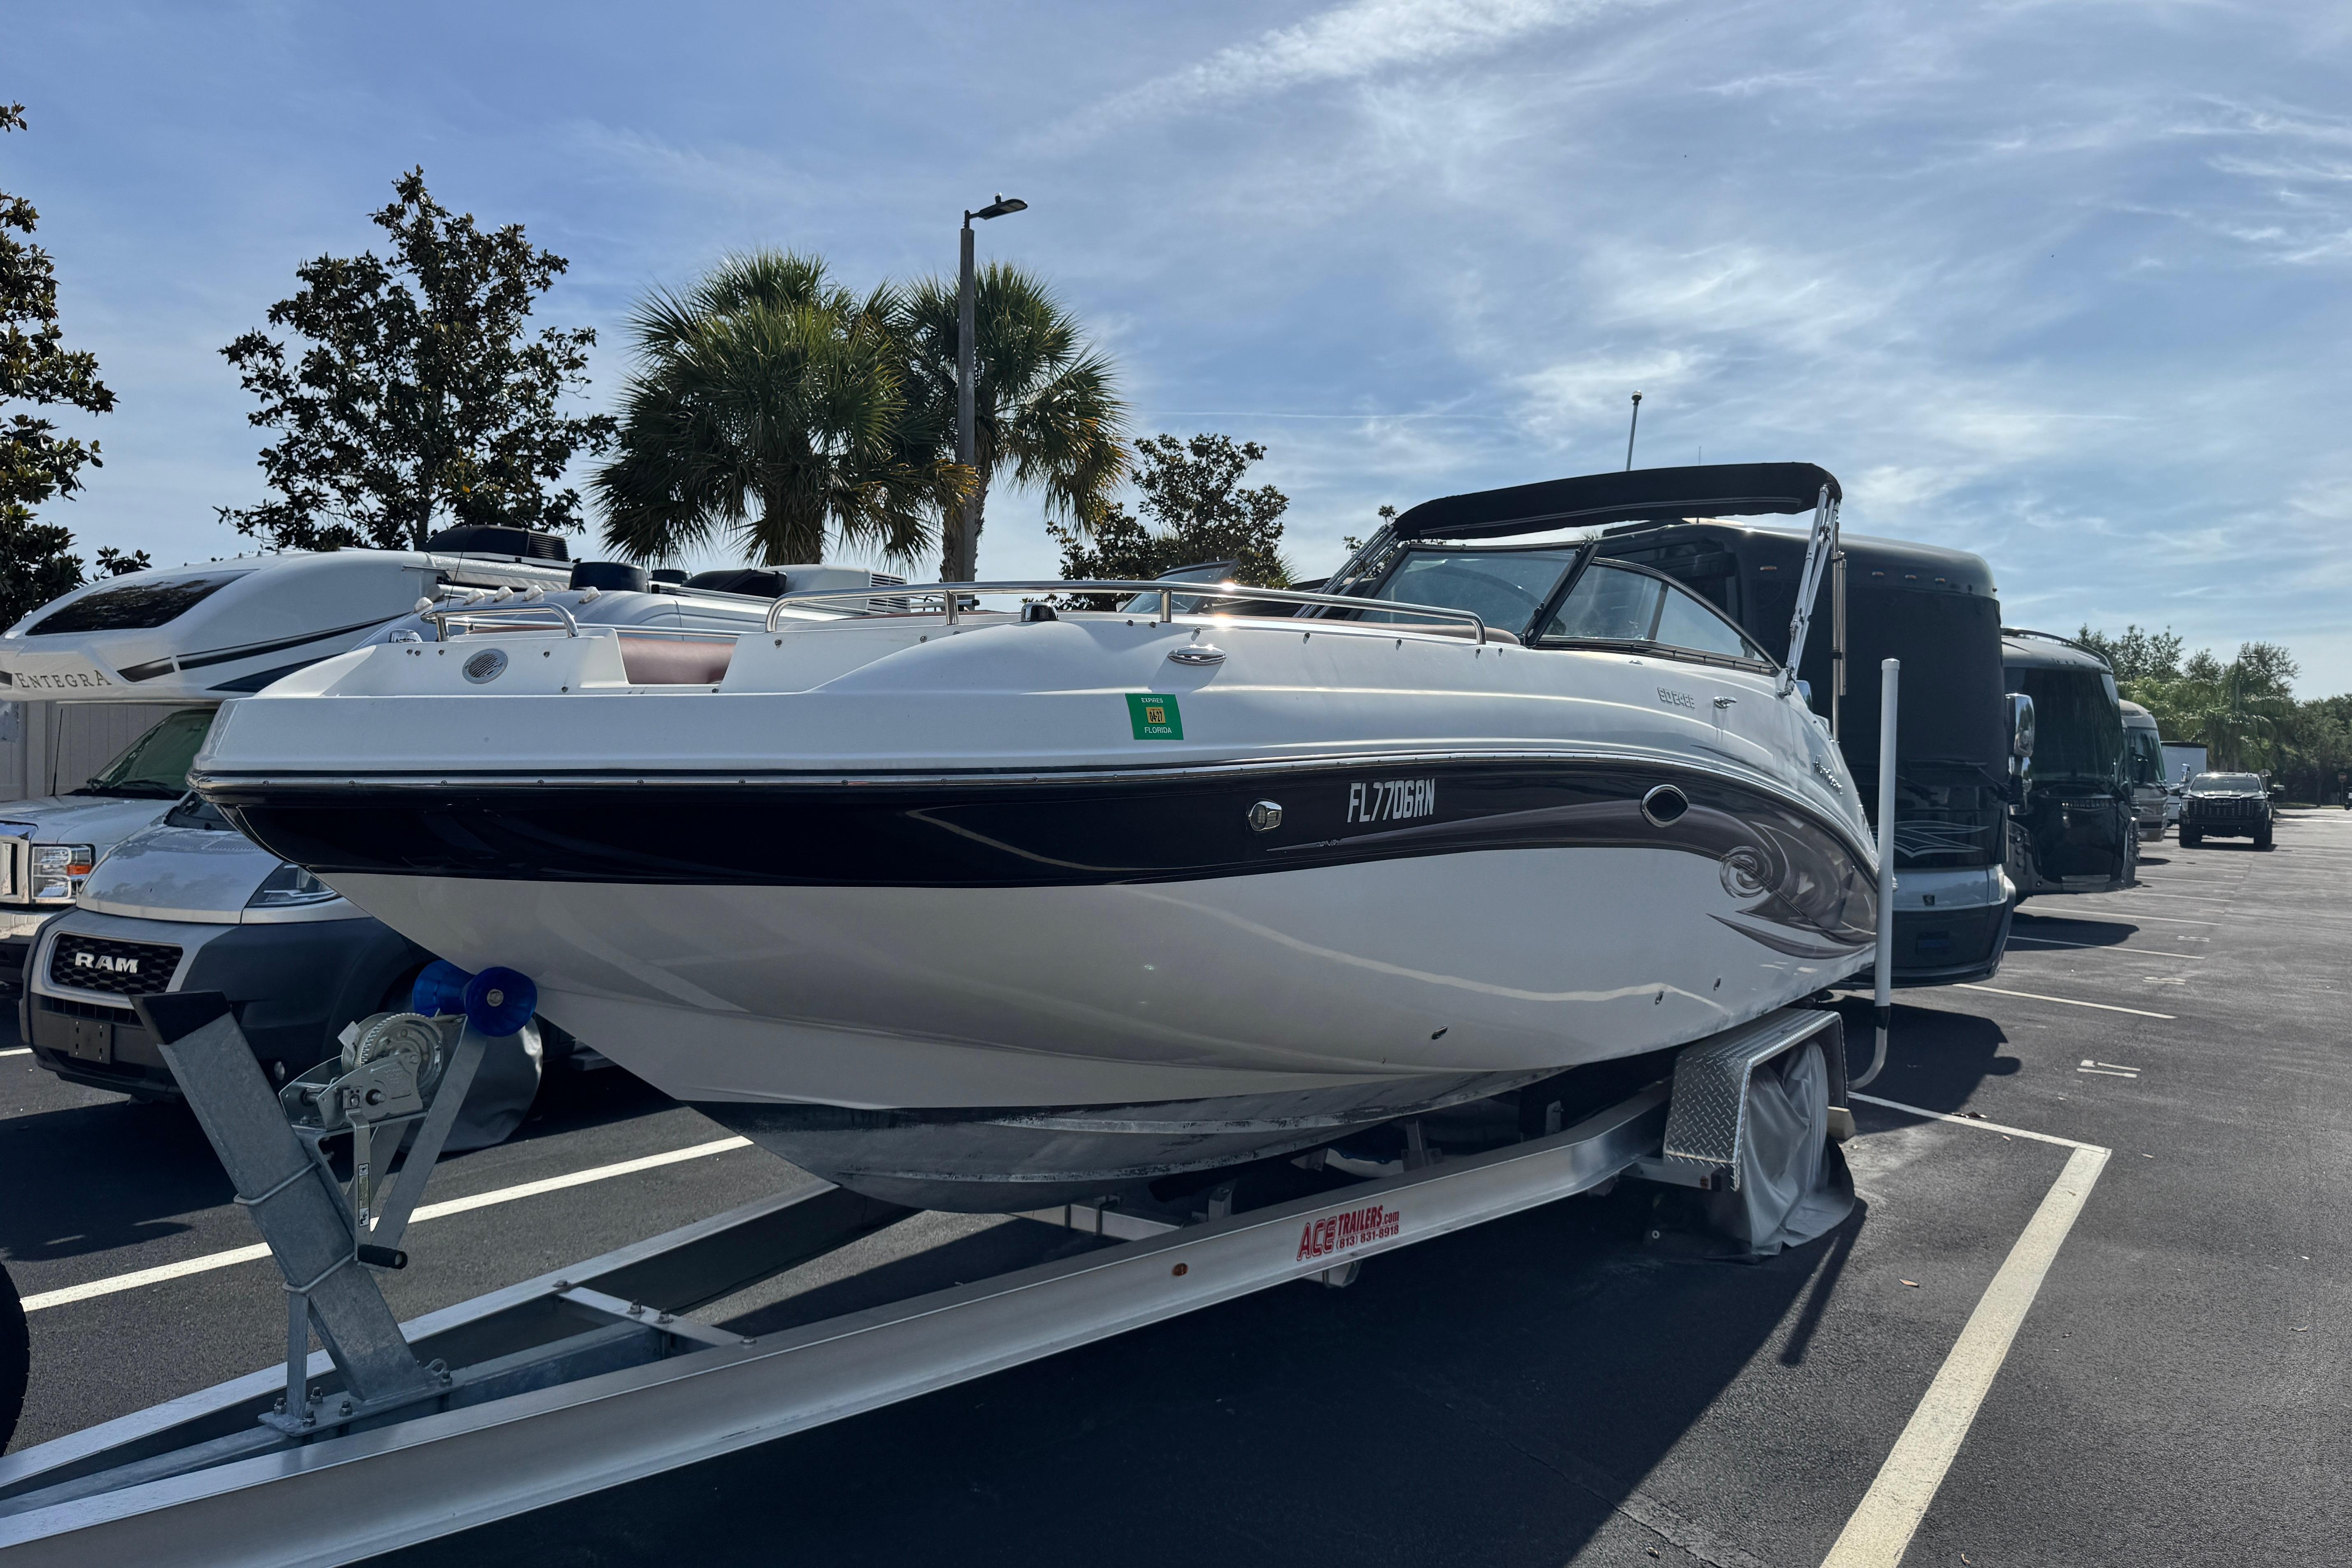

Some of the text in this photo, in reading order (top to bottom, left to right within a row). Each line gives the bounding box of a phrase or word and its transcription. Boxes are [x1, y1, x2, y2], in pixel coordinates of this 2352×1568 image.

[15, 670, 112, 688] ENTEGRA
[1347, 778, 1435, 823] FL7706RN
[75, 952, 139, 974] RAM
[1297, 1216, 1337, 1261] ACE
[1336, 1225, 1399, 1250] (813) 831-8918
